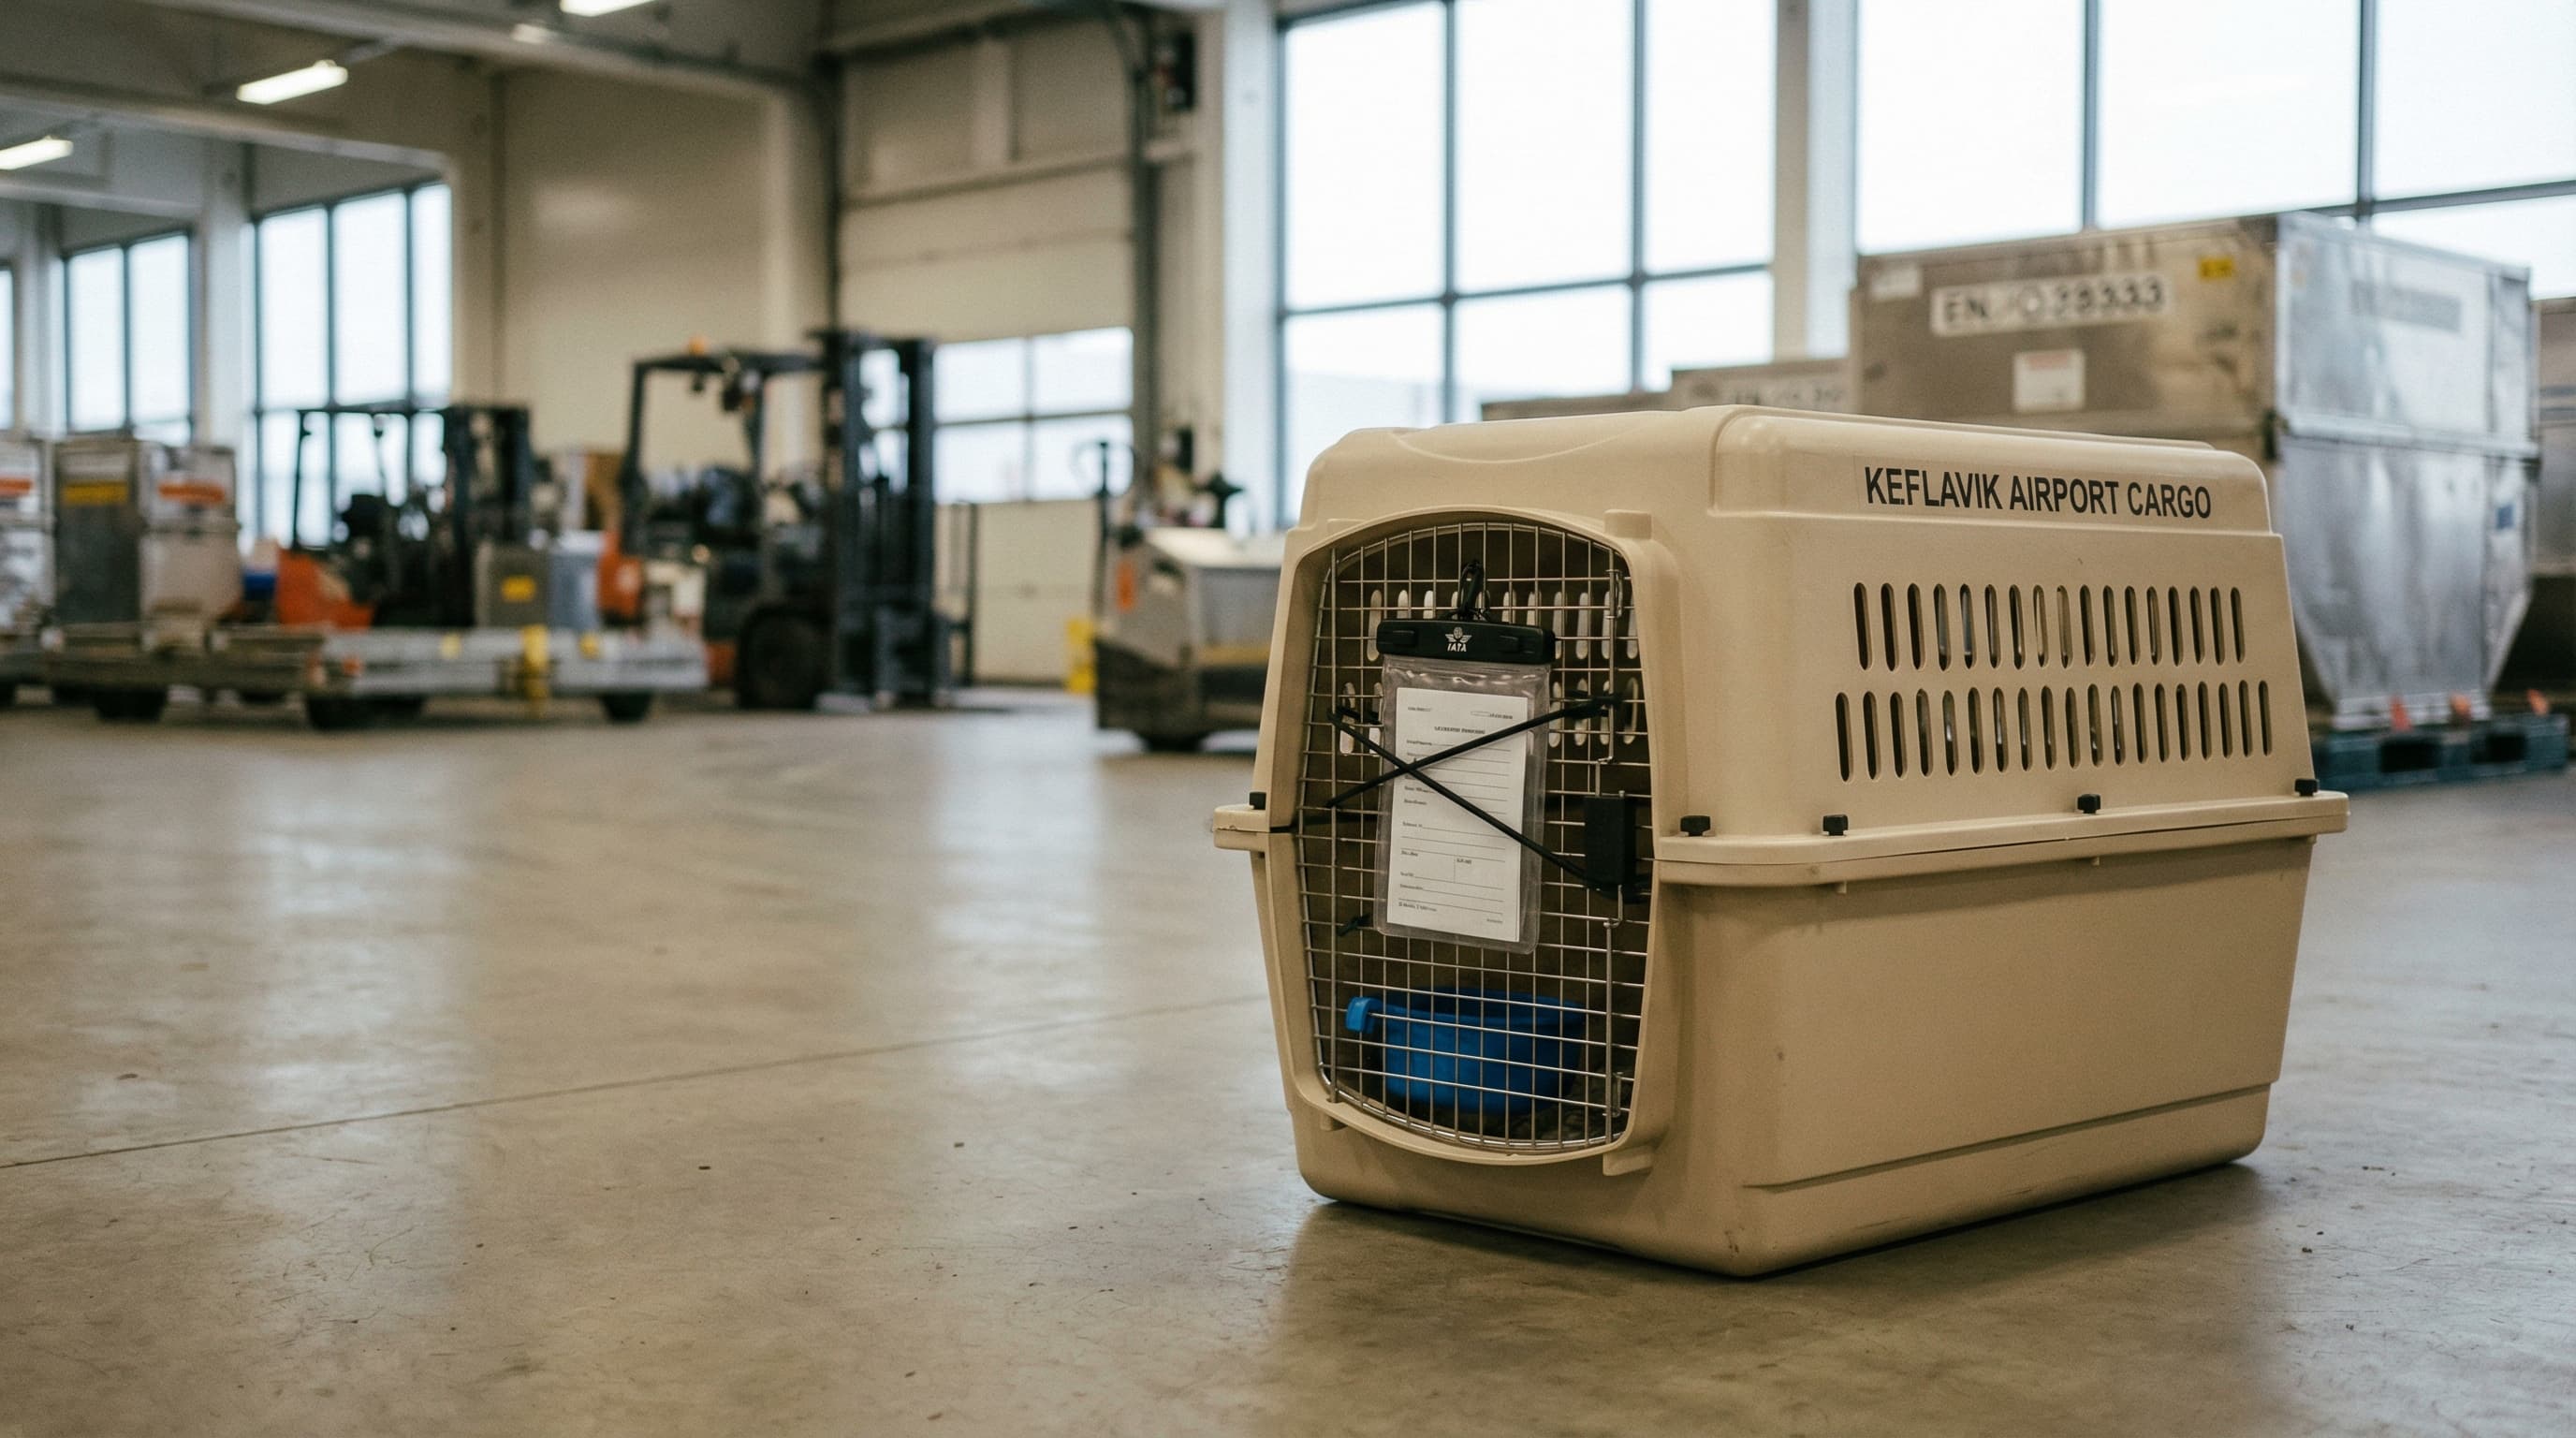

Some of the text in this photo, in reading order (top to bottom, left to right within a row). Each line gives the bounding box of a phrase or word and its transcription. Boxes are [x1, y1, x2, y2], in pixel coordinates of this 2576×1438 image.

[1865, 467, 2211, 519] KEFLAVIK AIRPORT CARGO
[1447, 642, 1467, 653] IATA
